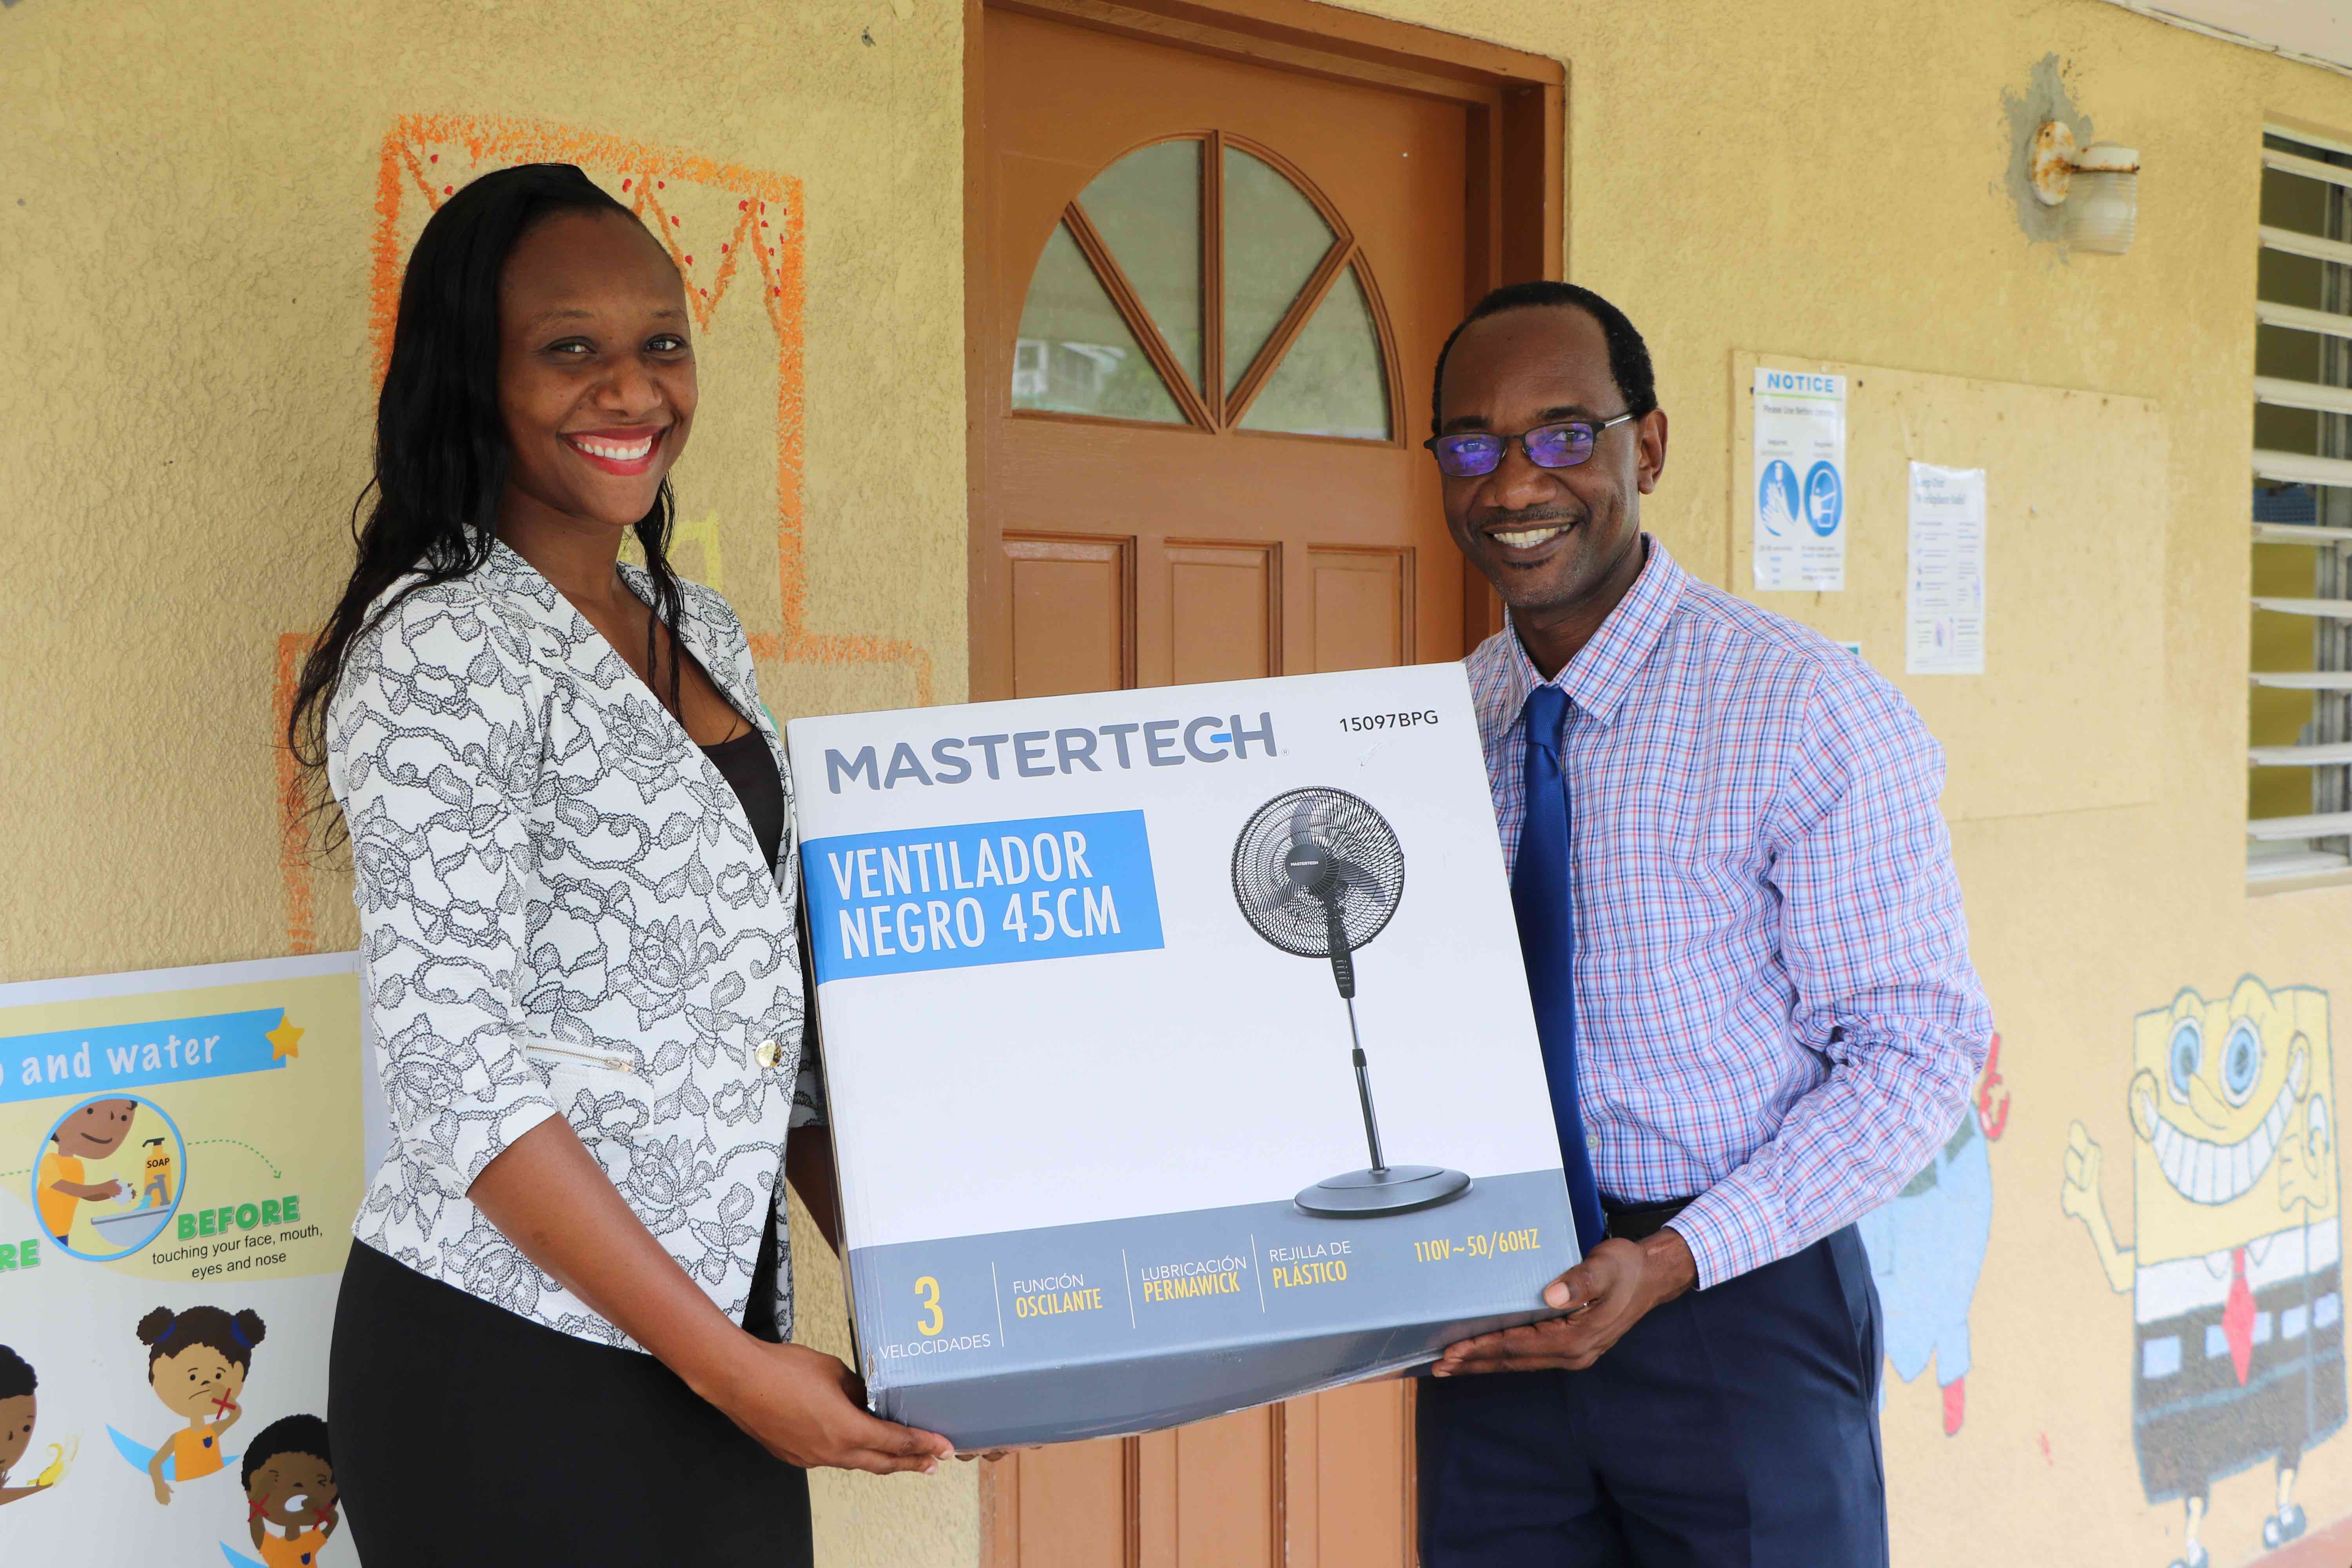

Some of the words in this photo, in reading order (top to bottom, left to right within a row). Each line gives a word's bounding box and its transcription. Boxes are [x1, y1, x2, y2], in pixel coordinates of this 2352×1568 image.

[1768, 373, 1834, 393] NOTICE
[1339, 710, 1439, 732] 15097BPG
[824, 712, 1277, 795] MASTERTECH
[828, 831, 1093, 900] VENTILADOR
[839, 897, 986, 960] NEGRO
[1003, 886, 1121, 943] 45CM
[22, 1042, 91, 1085] and
[107, 1035, 220, 1075] water
[147, 1158, 170, 1169] SOAP
[177, 1195, 300, 1241] BEFORE
[152, 1246, 208, 1265] touching
[212, 1239, 241, 1256] your
[245, 1234, 276, 1247] face,
[279, 1224, 323, 1242] mouth,
[1269, 1244, 1327, 1262] REJILLA
[1330, 1240, 1352, 1254] DE
[191, 1263, 223, 1279] eyes
[227, 1256, 251, 1272] and
[255, 1253, 287, 1267] nose
[1141, 1255, 1247, 1281] LUBRICACIÓN
[1272, 1261, 1348, 1289] PLÁSTICO
[1013, 1273, 1084, 1294] FUNCIÓN
[1144, 1271, 1241, 1303] PERMAWICK
[915, 1276, 944, 1336] 3
[1016, 1288, 1103, 1318] OSCILANTE
[879, 1333, 991, 1359] VELOCIDADES
